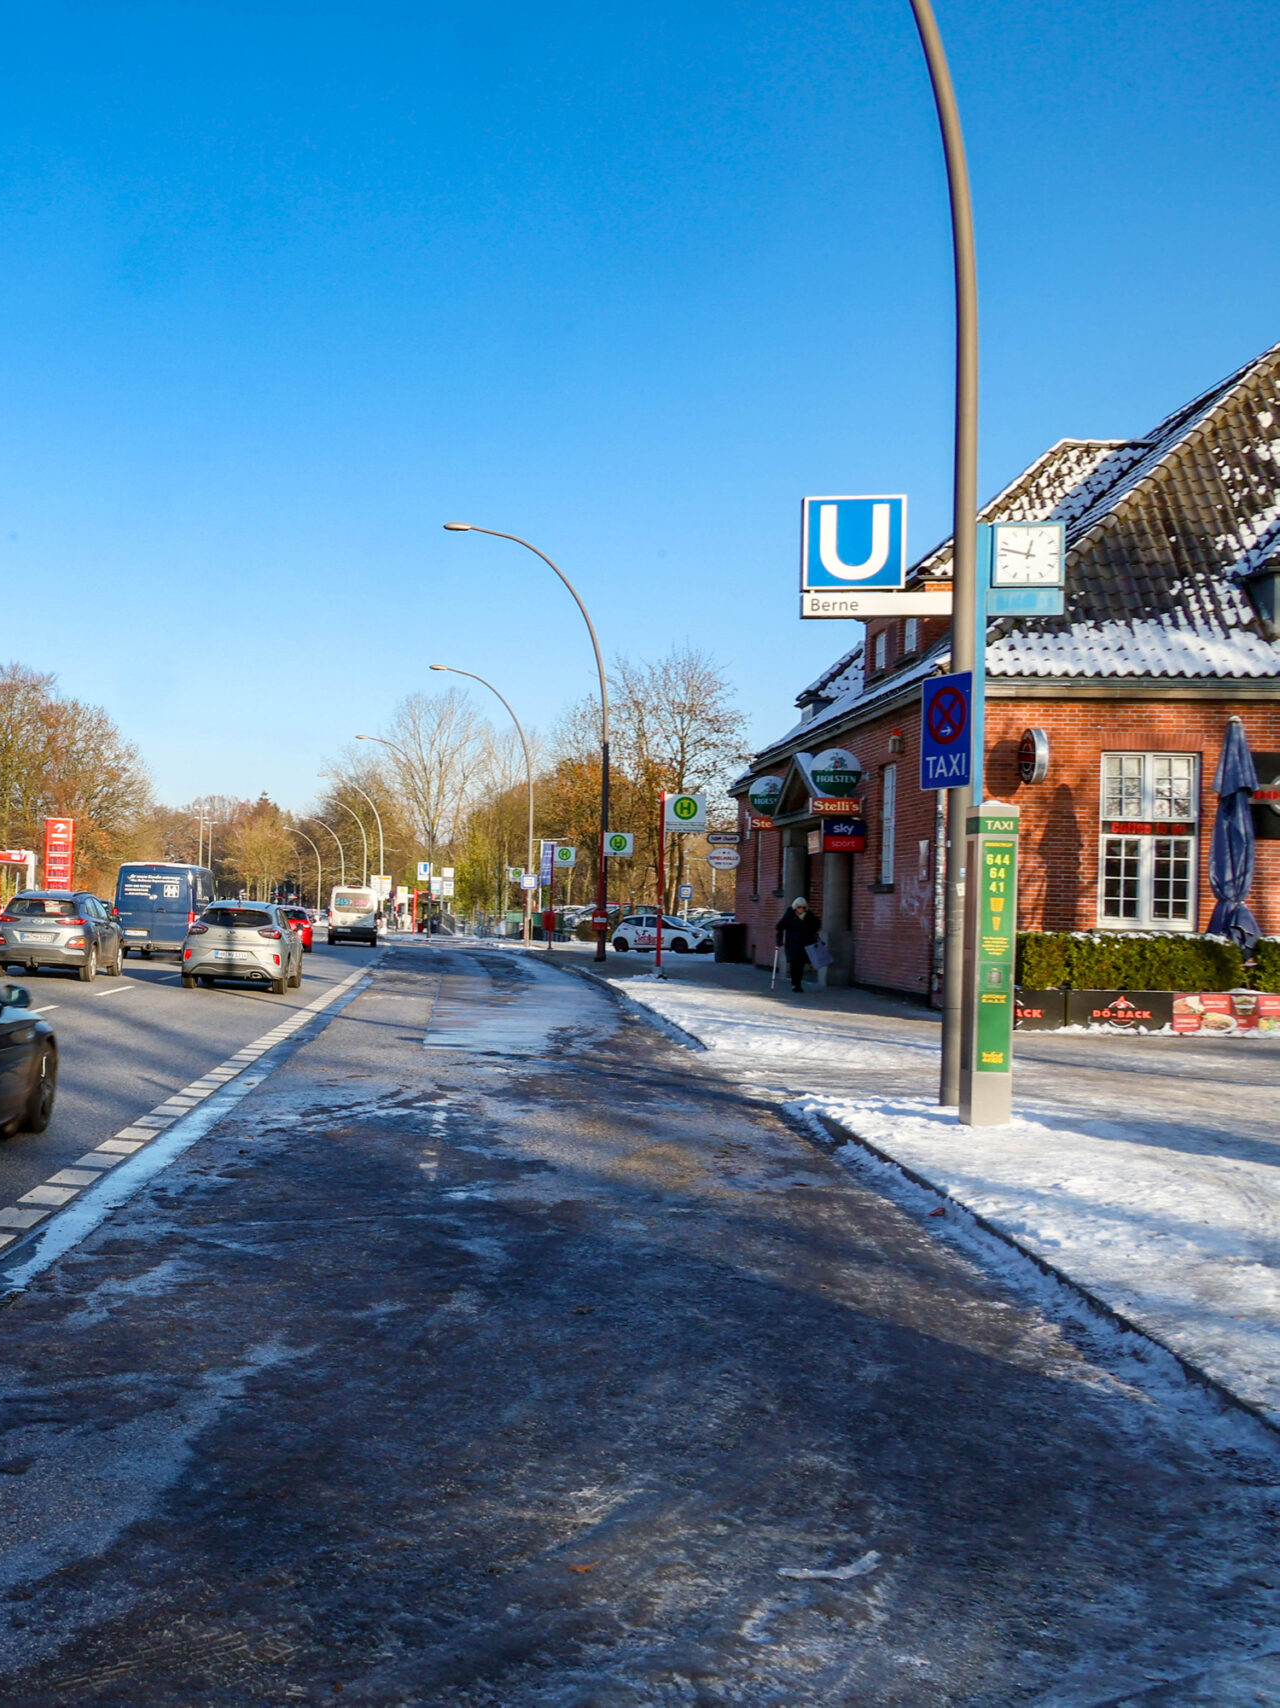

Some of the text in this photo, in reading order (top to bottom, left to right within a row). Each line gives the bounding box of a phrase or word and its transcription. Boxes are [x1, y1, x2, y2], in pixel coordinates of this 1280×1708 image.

[820, 503, 890, 581] U
[810, 598, 859, 612] Berne
[925, 752, 966, 779] TAXI
[816, 774, 856, 783] HOLSTEN
[813, 800, 860, 811] Stelli's
[751, 818, 772, 828] Ste
[984, 820, 1014, 831] TAXI
[1111, 822, 1152, 834] Coffee
[833, 823, 855, 835] sky
[831, 839, 855, 848] sport
[988, 881, 1005, 893] 41
[1092, 1008, 1152, 1019] DÖ-BACK
